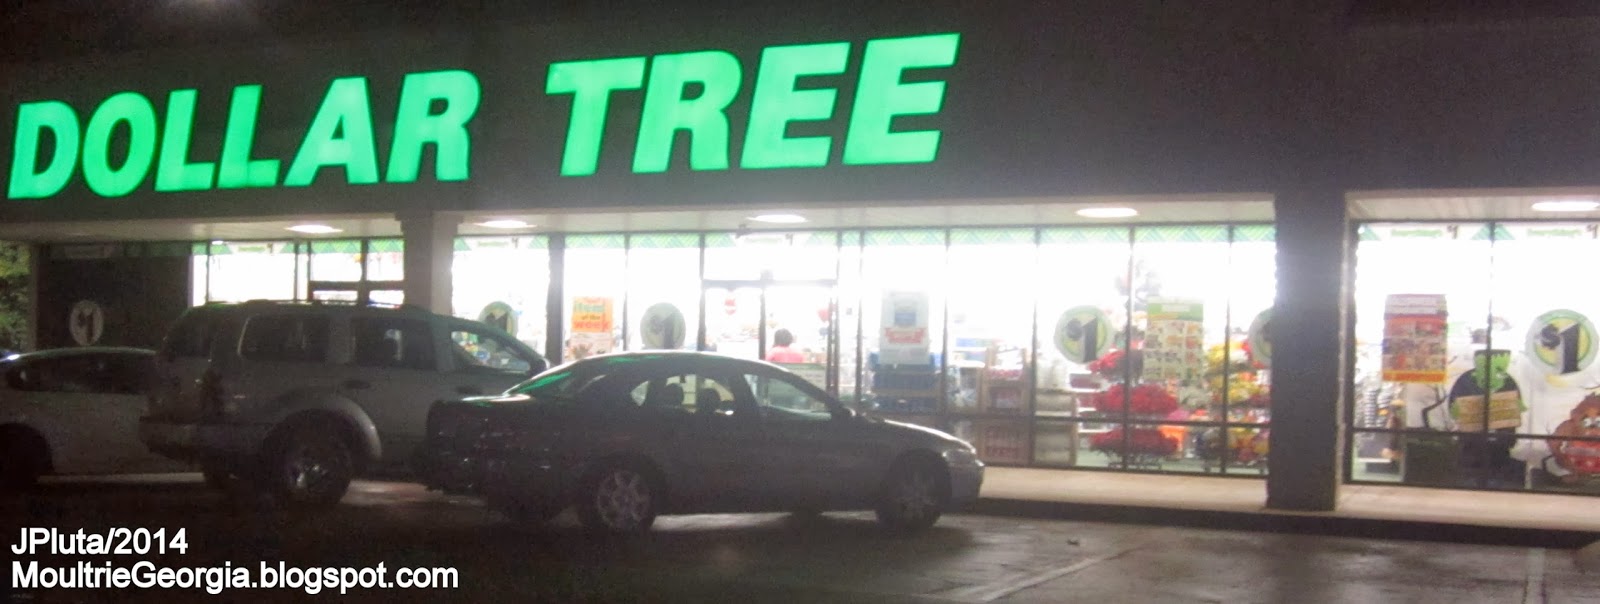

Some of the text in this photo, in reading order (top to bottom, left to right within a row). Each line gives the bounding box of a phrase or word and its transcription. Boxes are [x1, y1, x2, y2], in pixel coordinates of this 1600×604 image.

[8, 34, 960, 198] DOLLAR TREE
[1064, 316, 1099, 363] $1
[1537, 322, 1581, 375] $1
